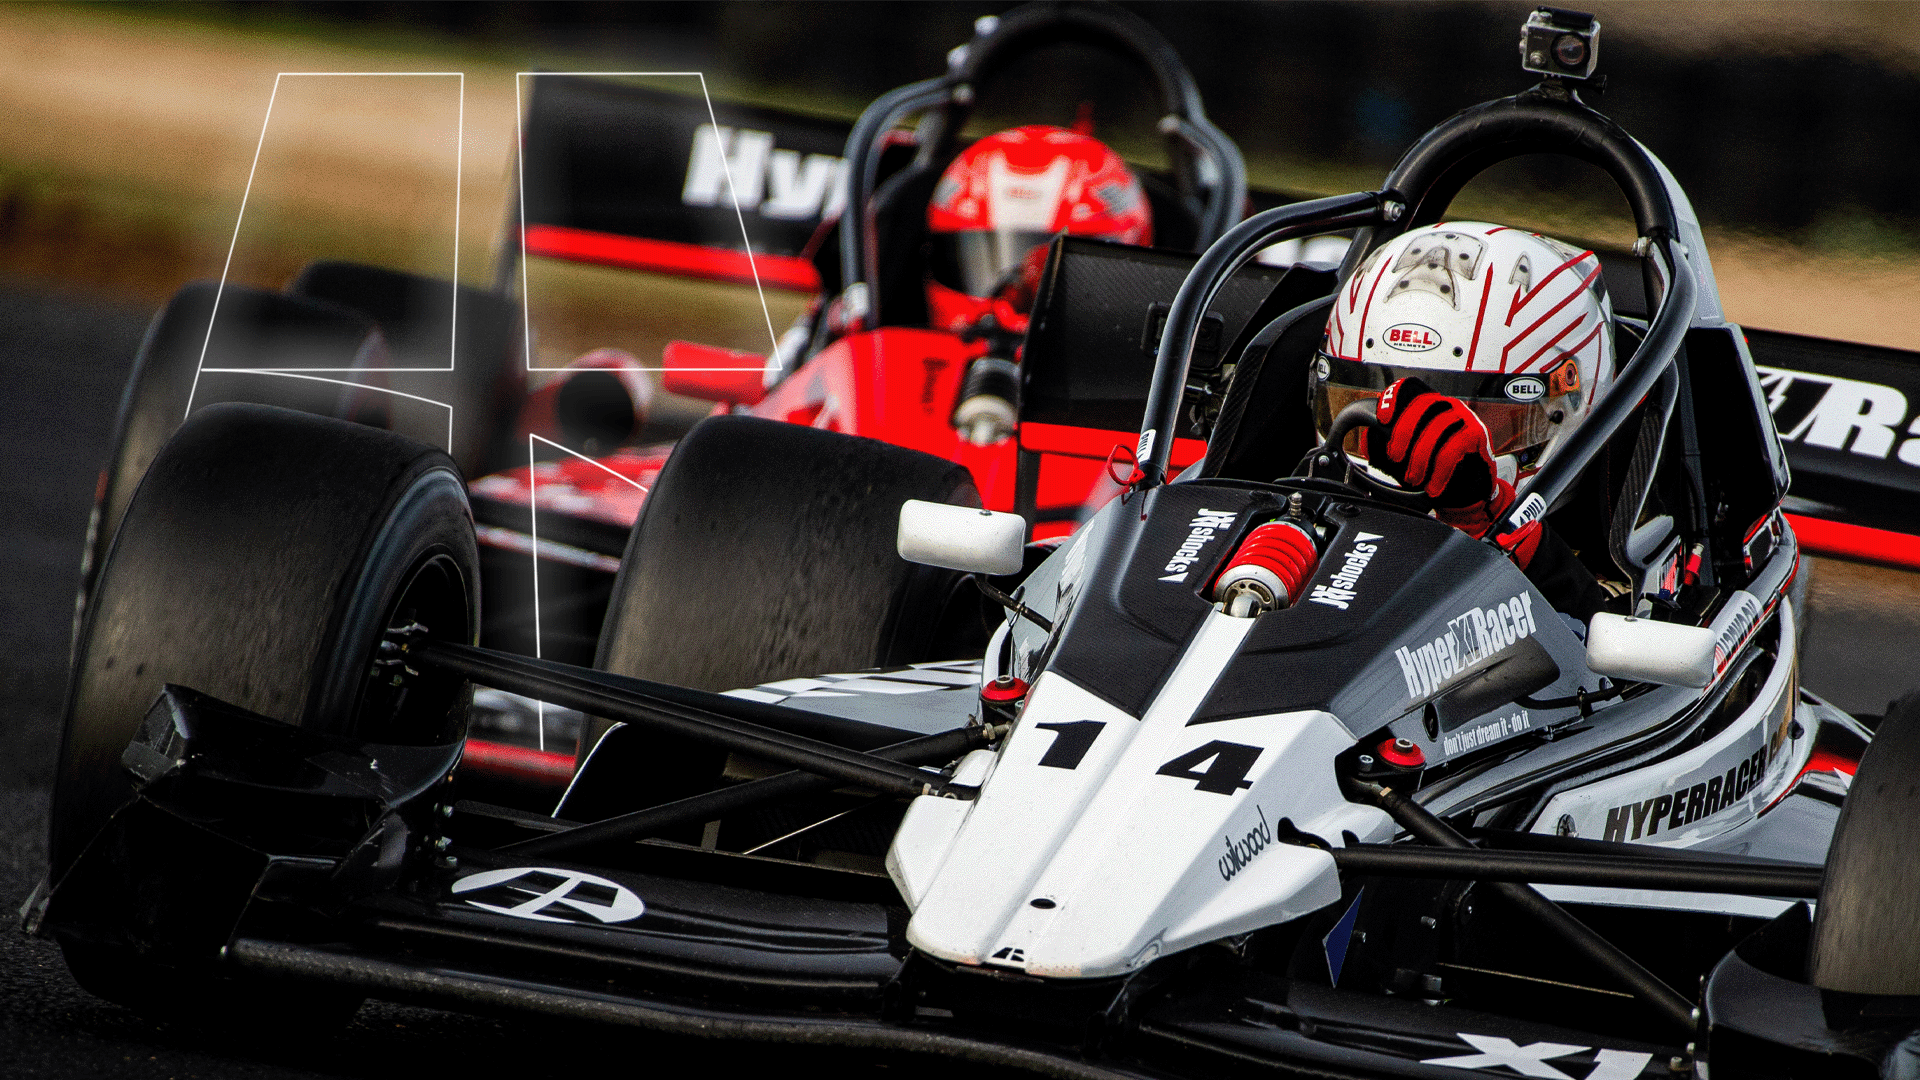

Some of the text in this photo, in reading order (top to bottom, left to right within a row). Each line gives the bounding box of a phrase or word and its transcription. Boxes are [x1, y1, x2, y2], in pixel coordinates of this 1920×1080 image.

[1512, 384, 1541, 394] BELL
[1443, 732, 1463, 756] don't
[1461, 729, 1477, 752] just
[1476, 725, 1501, 746] dream
[1500, 717, 1509, 737] it
[1511, 712, 1523, 733] do
[1521, 709, 1531, 729] it
